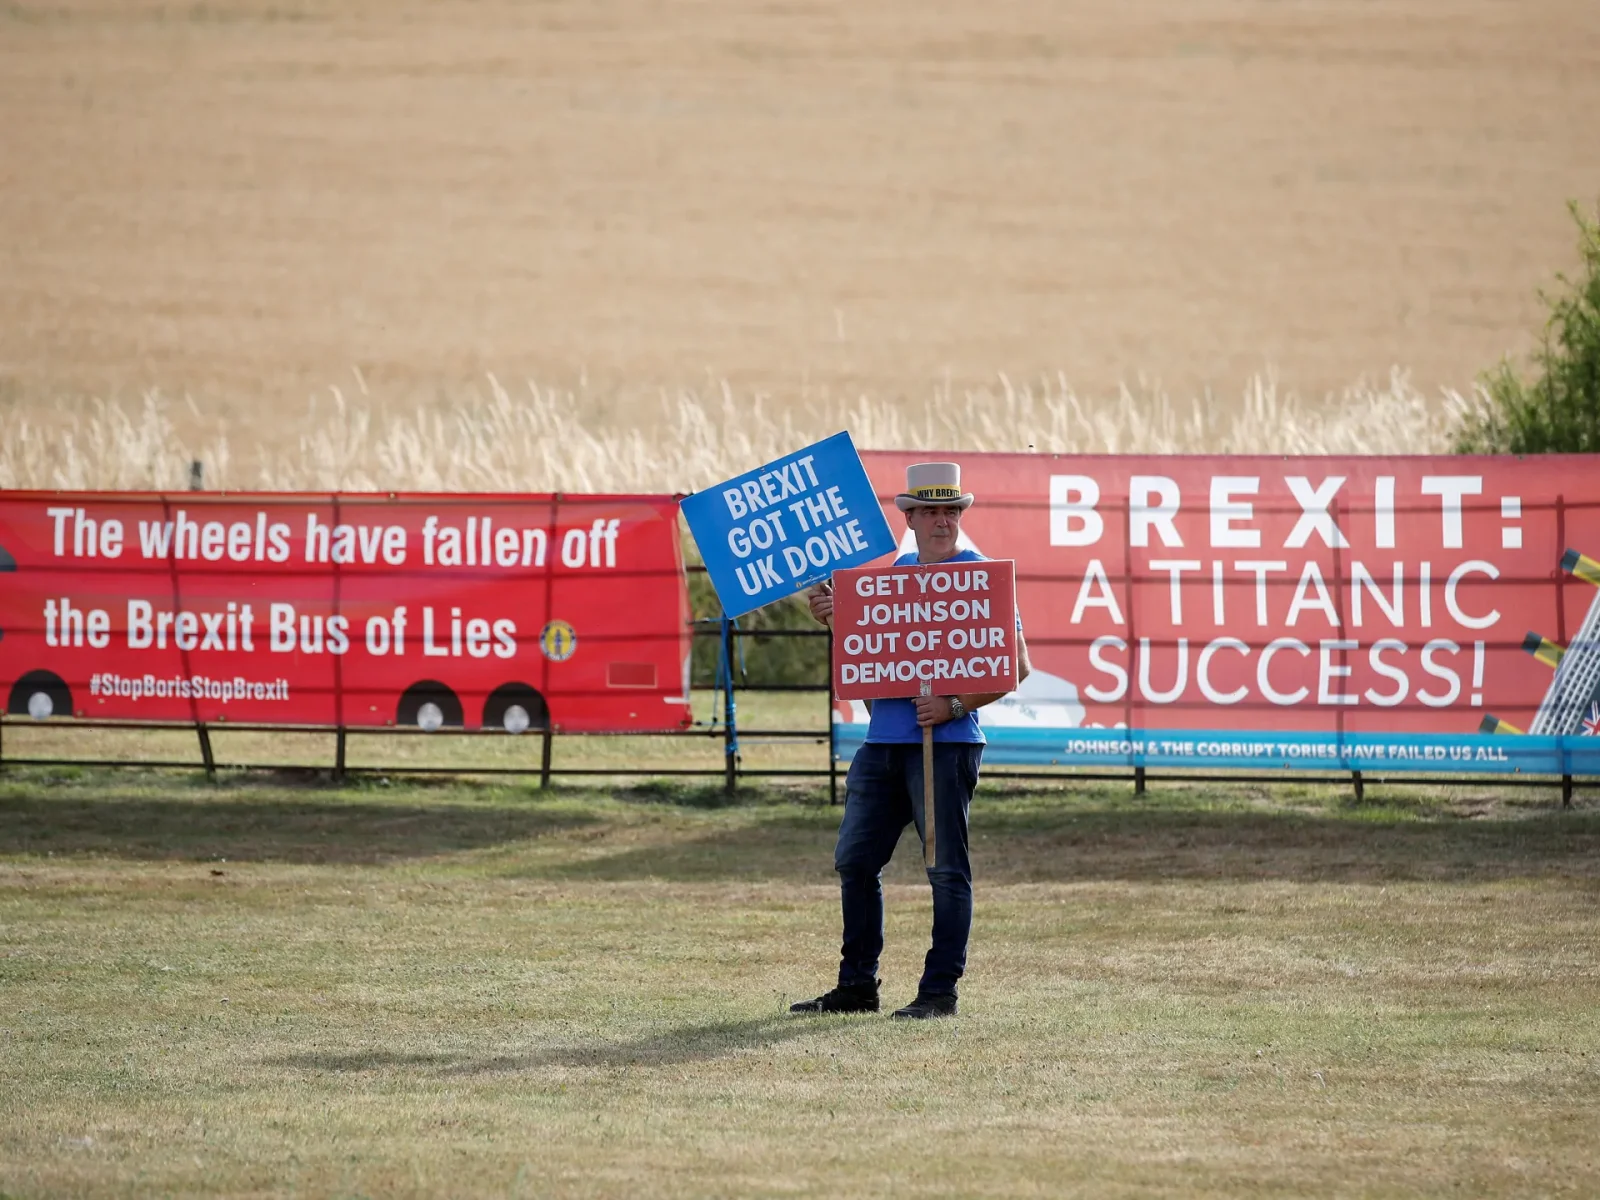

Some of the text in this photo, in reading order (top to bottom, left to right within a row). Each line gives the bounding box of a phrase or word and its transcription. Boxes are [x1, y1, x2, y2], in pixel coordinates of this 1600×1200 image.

[722, 454, 820, 520] BREXIT
[916, 488, 933, 498] WHY
[1049, 475, 1521, 548] BREXIT:
[47, 508, 620, 567] The wheels have fallen off
[728, 485, 850, 558] GOT THE
[735, 518, 869, 596] UK DONE
[856, 571, 989, 596] GET YOUR
[857, 599, 989, 625] JOHNSON
[1070, 559, 1500, 628] A TITANIC
[44, 598, 110, 648] the
[128, 600, 254, 651] Brexit
[270, 603, 348, 653] Bus
[366, 607, 406, 655] of
[424, 607, 516, 658] Lies
[844, 628, 1005, 655] OUT OF OUR
[91, 674, 288, 703] #StopBorisStopBrexit
[841, 656, 1010, 685] DEMOCRACY!
[1084, 635, 1485, 706] SUCCESS!
[1065, 739, 1509, 762] JOHNSON & THE CORRUPT TORIES HAVE FAILED US ALL
